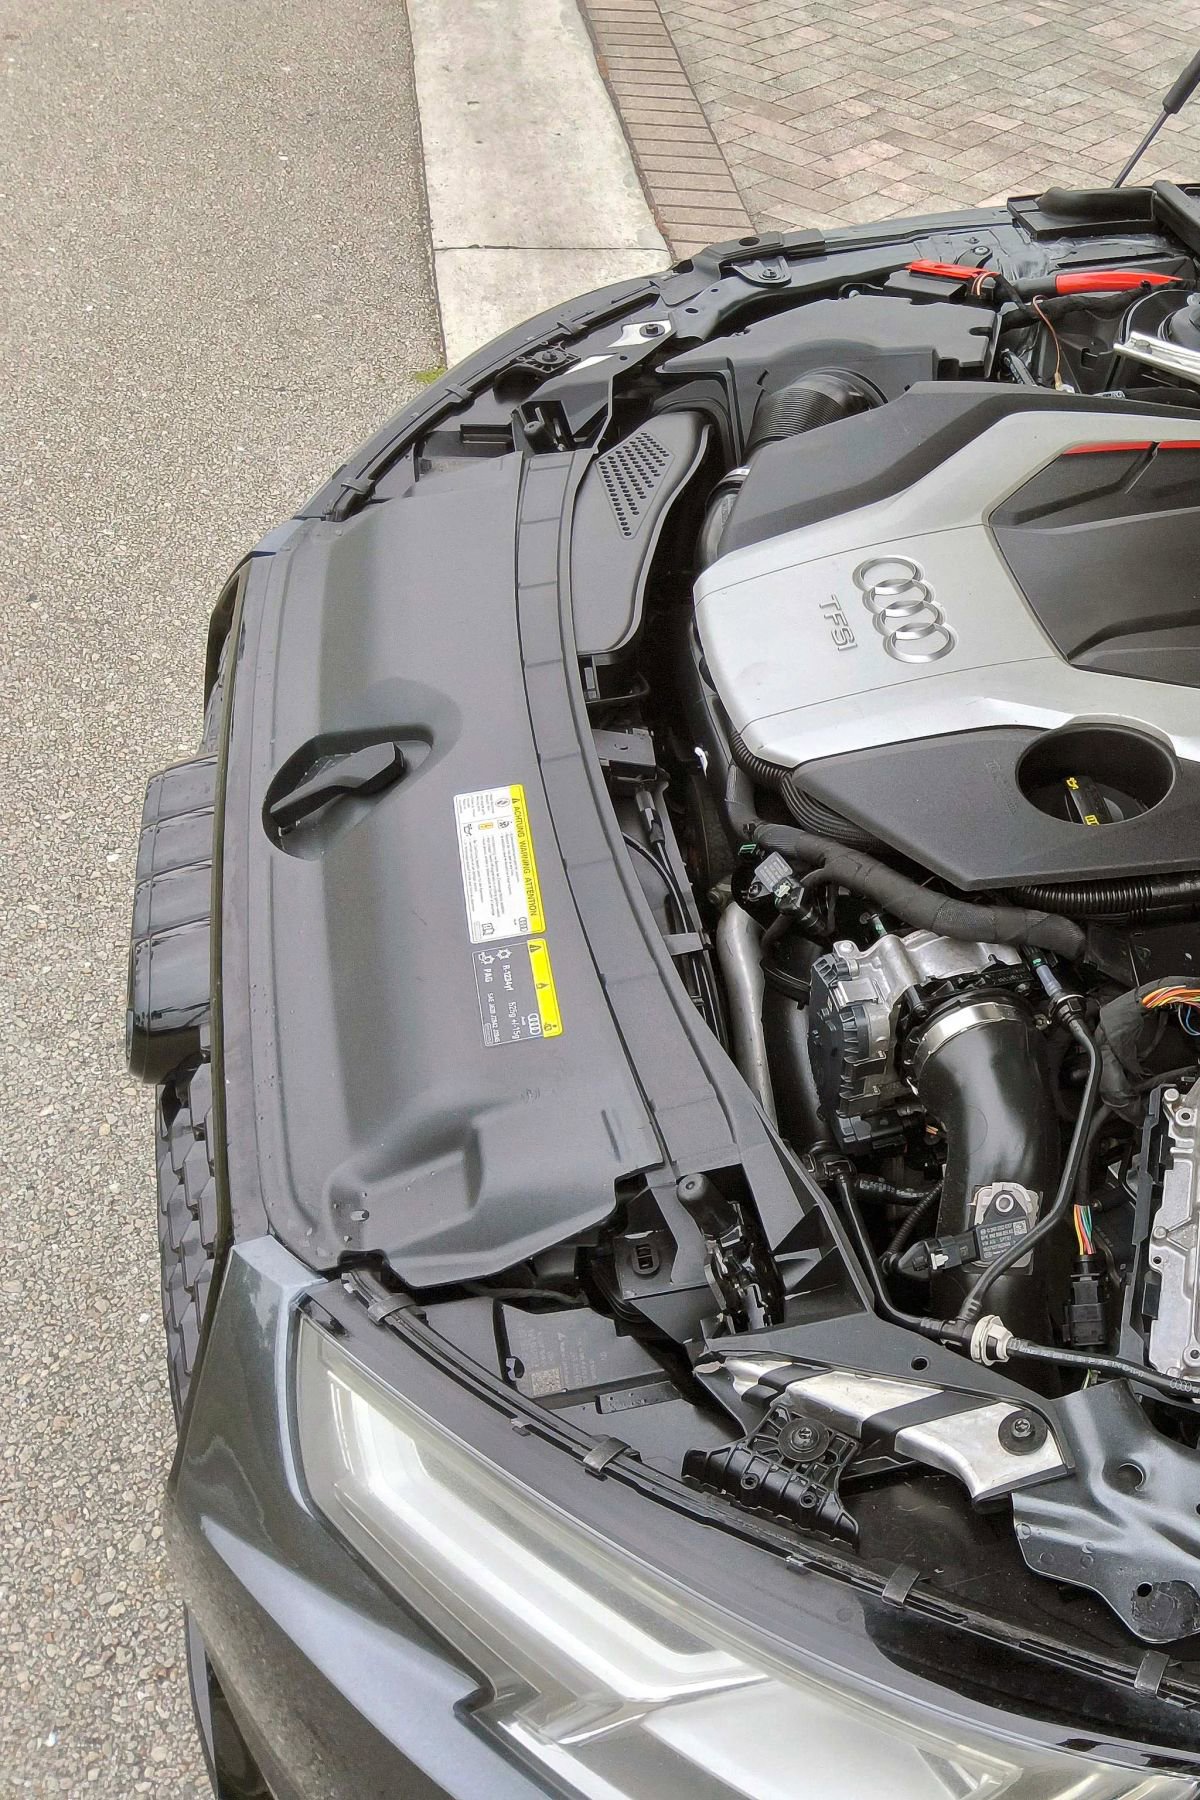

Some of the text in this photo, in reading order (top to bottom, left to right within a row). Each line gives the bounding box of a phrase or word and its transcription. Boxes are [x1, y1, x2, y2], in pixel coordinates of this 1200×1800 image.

[818, 594, 858, 651] TFSI
[512, 806, 538, 916] ACHTUNG WARNING ATTENTION
[484, 968, 493, 983] PAG
